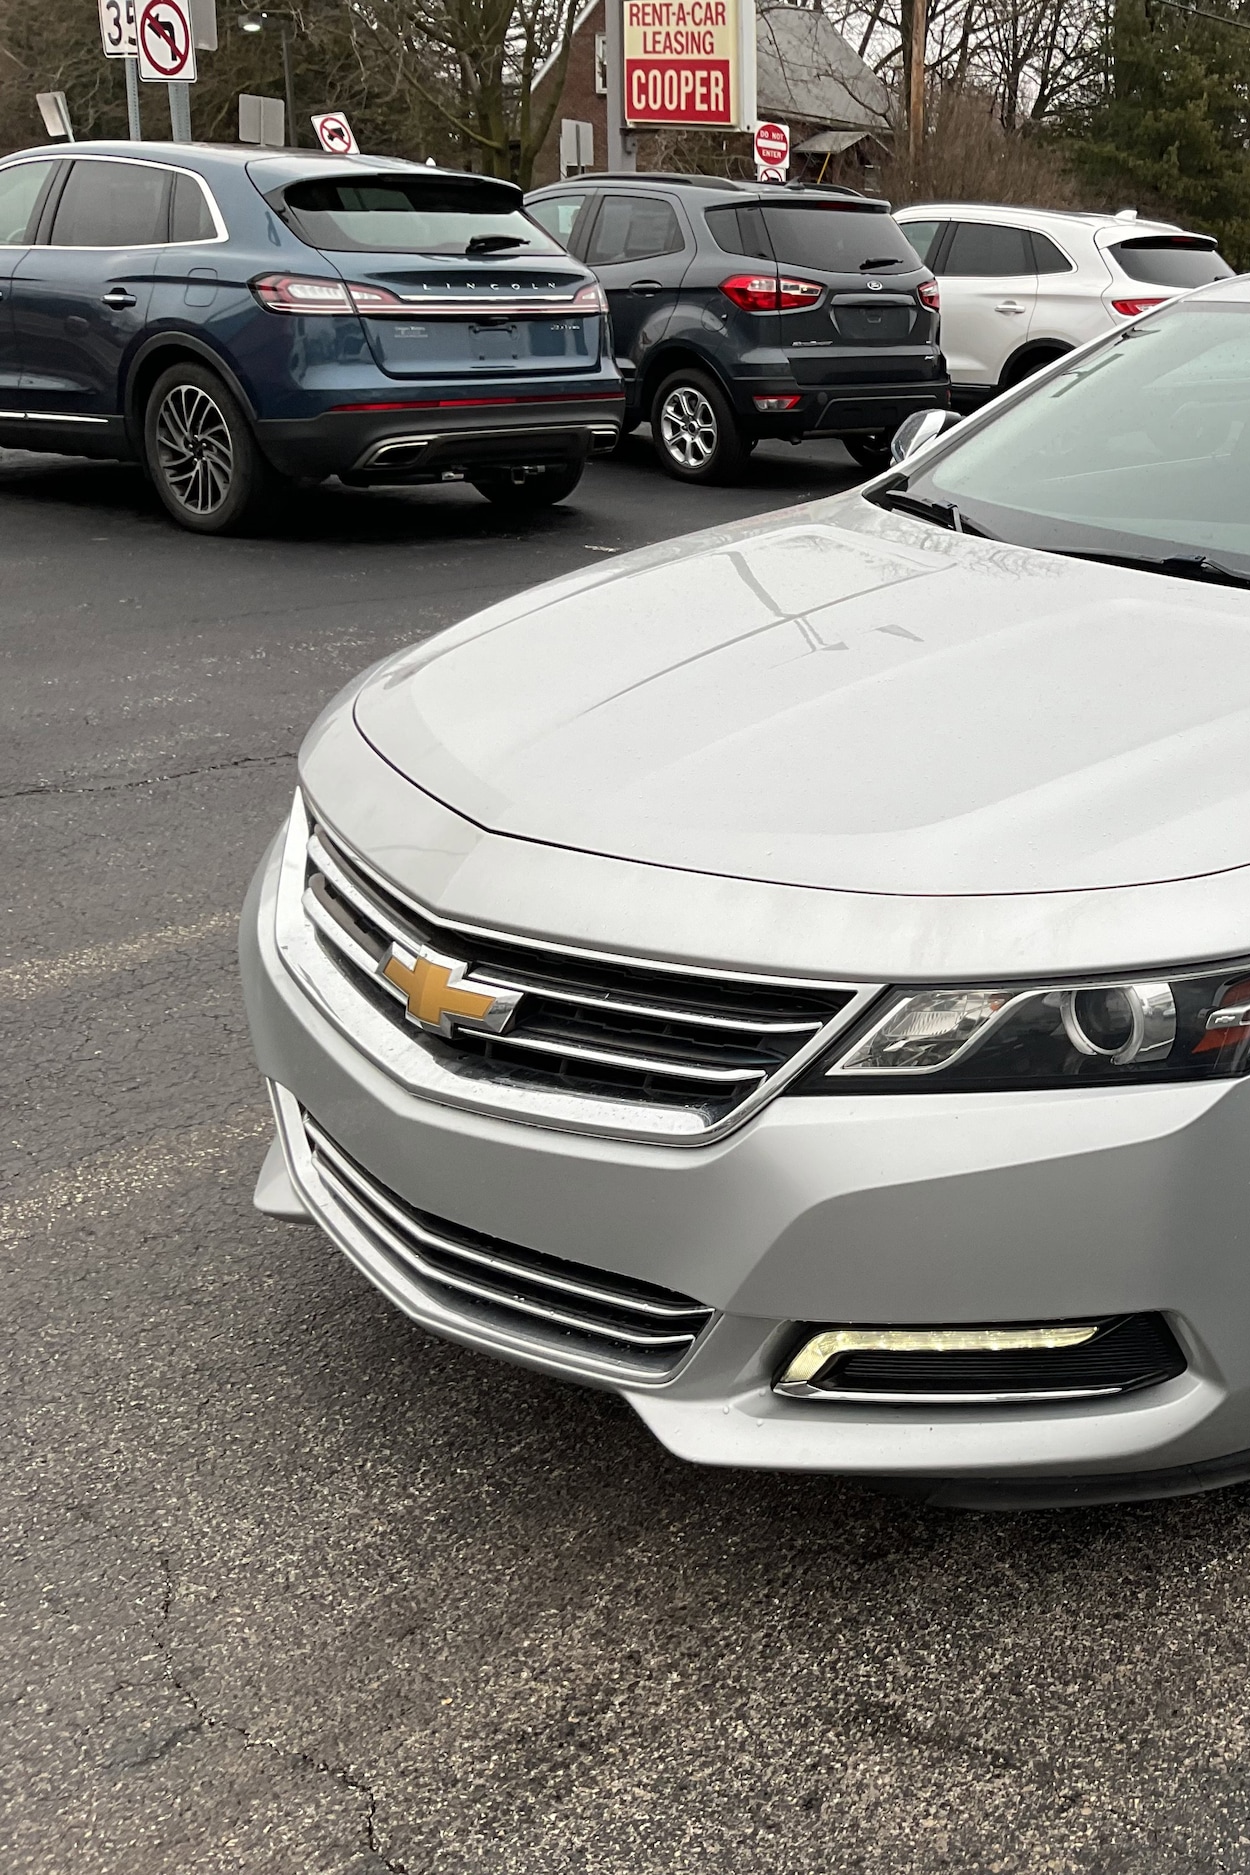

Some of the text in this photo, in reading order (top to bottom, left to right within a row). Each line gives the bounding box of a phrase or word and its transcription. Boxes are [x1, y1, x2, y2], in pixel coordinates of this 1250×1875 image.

[629, 2, 726, 26] RENT-A-CAR
[643, 30, 715, 55] LEASING
[632, 69, 725, 111] COOPER
[760, 130, 784, 140] DO NOT
[761, 149, 782, 159] ENTER
[423, 282, 556, 291] LINCOLN
